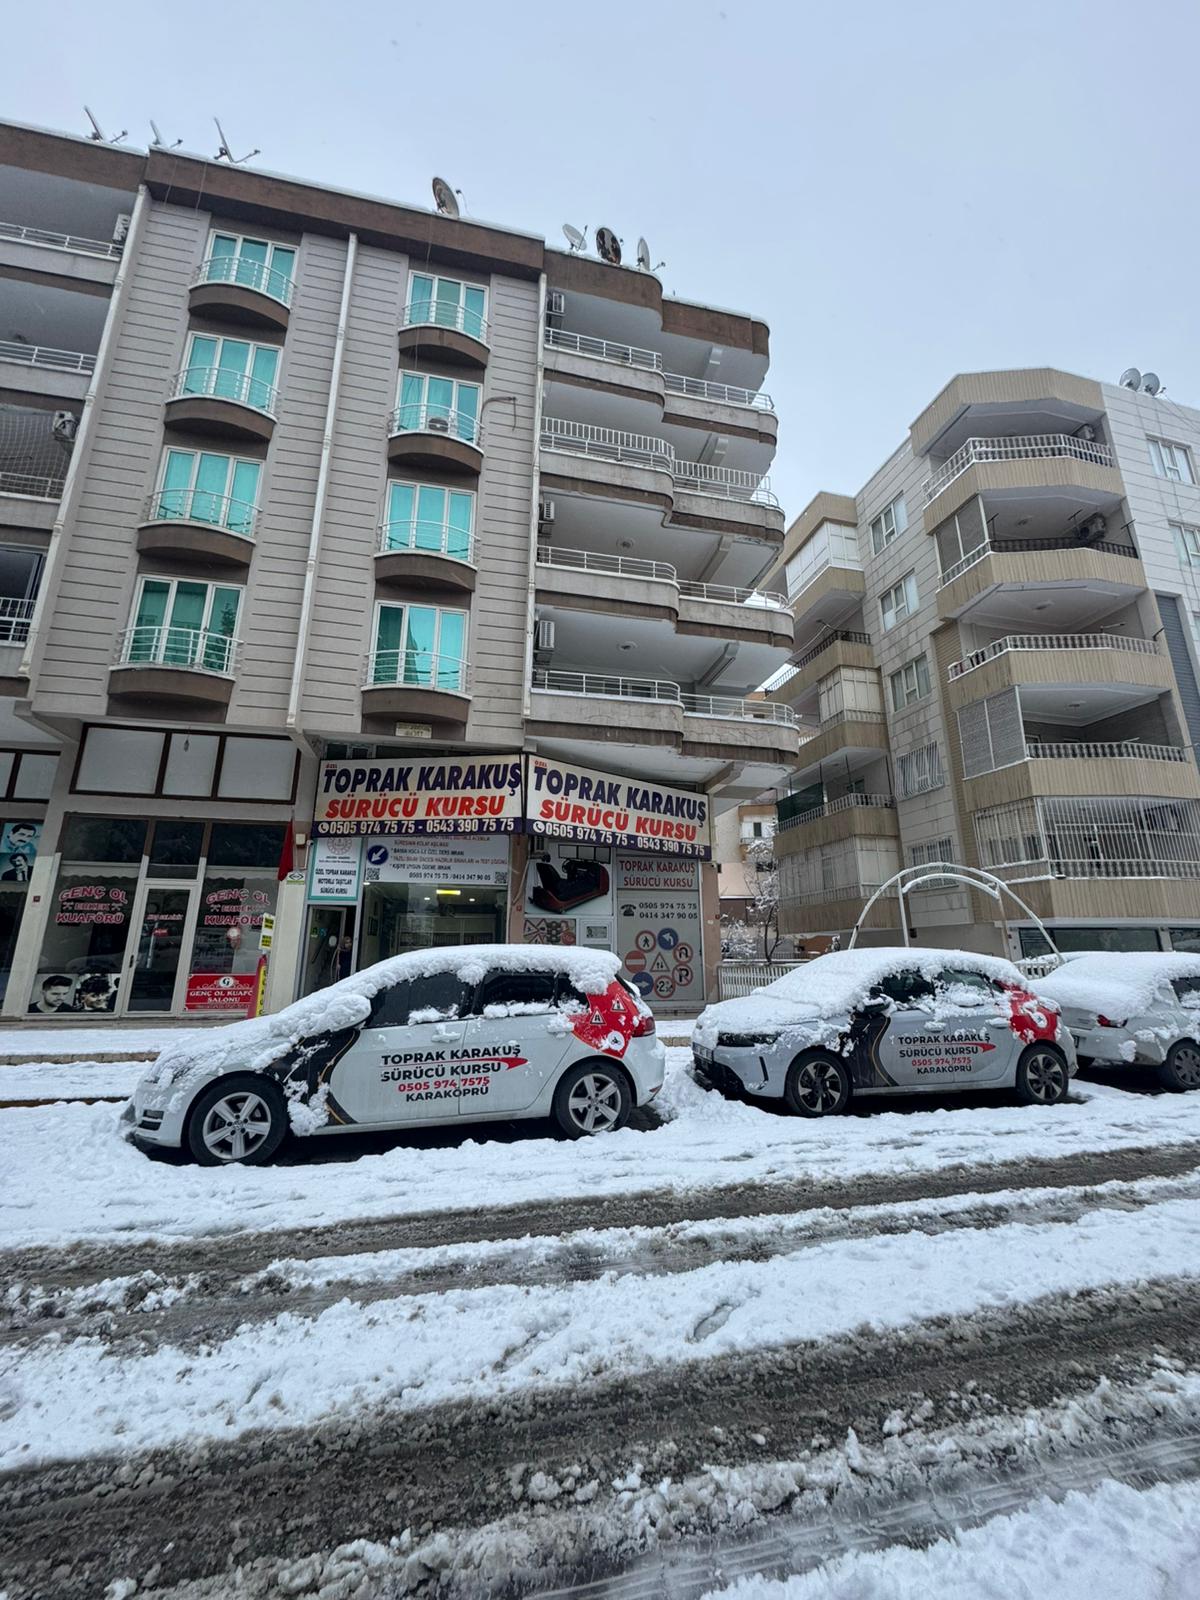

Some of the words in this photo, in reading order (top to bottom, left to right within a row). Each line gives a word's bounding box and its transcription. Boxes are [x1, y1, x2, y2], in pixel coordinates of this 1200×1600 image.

[323, 766, 413, 793] TOPRAK
[416, 763, 521, 797] KARAKUŞ
[325, 792, 419, 819] SÜRÜCÜ
[425, 796, 505, 817] KURSU
[534, 766, 622, 806] TOPRAK
[626, 786, 707, 828] KARAKUŞ
[330, 821, 357, 834] 0505
[360, 821, 380, 834] 974
[384, 821, 398, 833] 75
[402, 820, 415, 833] 75
[426, 819, 454, 833] 0543
[457, 819, 477, 832] 390
[482, 818, 497, 832] 75
[500, 818, 514, 831] 75
[539, 797, 629, 831] SÜRÜCÜ
[635, 816, 697, 842] KURSU
[545, 823, 574, 838] 0505
[576, 827, 597, 842] 974
[600, 831, 612, 844] 75
[616, 833, 628, 846] 75
[637, 836, 660, 851] 0543
[662, 840, 679, 853] 390
[681, 842, 692, 855] 75
[694, 844, 705, 856] 75
[620, 860, 654, 872] TOPRAK
[656, 861, 695, 876] KARAKUŞ
[624, 874, 660, 887] SÜRÜCÜ
[664, 878, 693, 887] KURSU
[59, 886, 106, 901] GENÇ
[109, 888, 128, 904] OL
[206, 888, 249, 904] GENÇ
[253, 890, 270, 905] OL
[56, 912, 124, 924] KUAFÖRÜ
[898, 1035, 940, 1045] TOPRAK
[381, 1051, 446, 1065] TOPRAK
[451, 1044, 521, 1059] KARAKUŞ
[899, 1046, 942, 1058] SÜRÜCÜ
[945, 1046, 979, 1056] KURSU
[952, 1056, 972, 1064] 7575
[381, 1065, 445, 1082] SÜRÜCÜ
[450, 1062, 501, 1076] KURSU
[917, 1064, 972, 1075] KARAKÖPRÜ
[398, 1081, 430, 1092] 0505
[433, 1079, 457, 1090] 974
[460, 1076, 490, 1087] 7575
[406, 1084, 489, 1102] KARAKÖPRÜ
